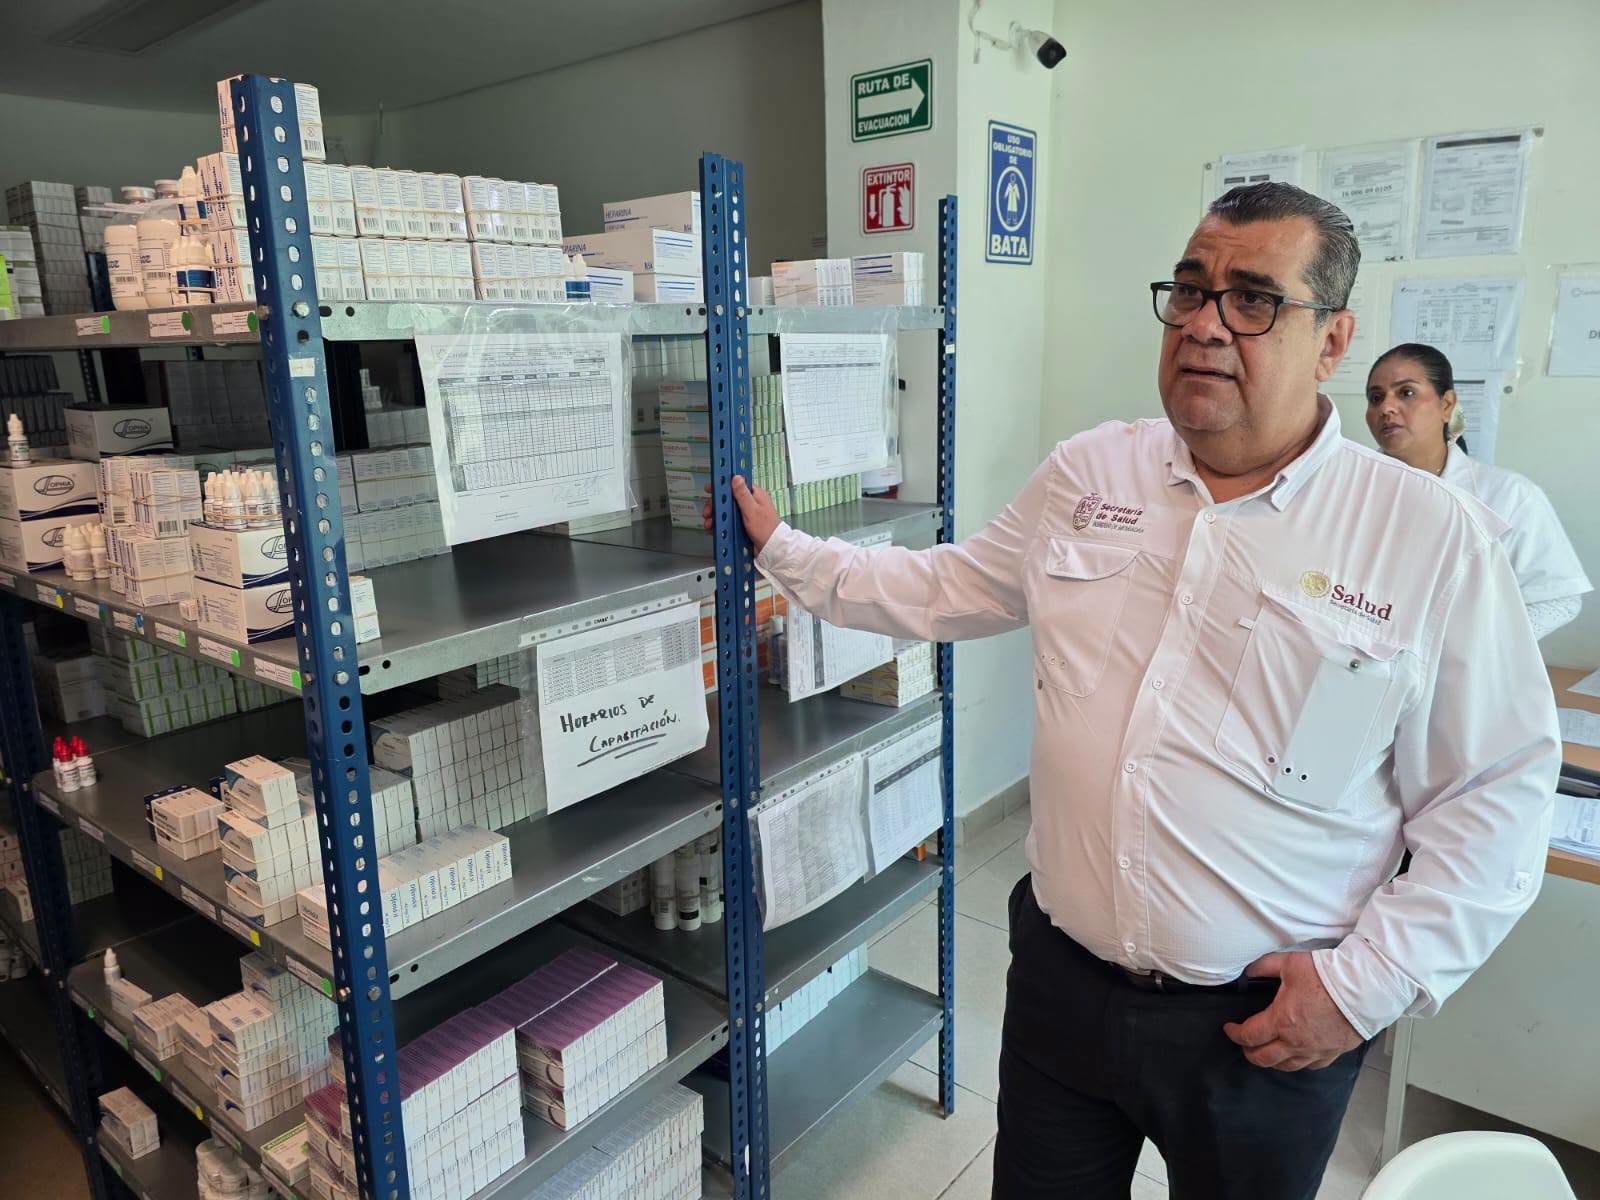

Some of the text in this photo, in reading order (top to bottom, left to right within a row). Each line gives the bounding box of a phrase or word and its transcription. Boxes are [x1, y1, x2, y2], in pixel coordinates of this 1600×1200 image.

[858, 73, 910, 95] RUTA DE
[858, 114, 910, 133] EVACUACION
[1007, 134, 1021, 145] USO
[992, 141, 1033, 158] OBLIGATORIO
[1009, 156, 1018, 165] DE
[867, 169, 911, 187] EXTINTOR
[991, 233, 1029, 257] BATA
[1096, 512, 1139, 525] de Salud
[1331, 584, 1393, 621] Salud
[560, 694, 655, 733] HORARIOS DE
